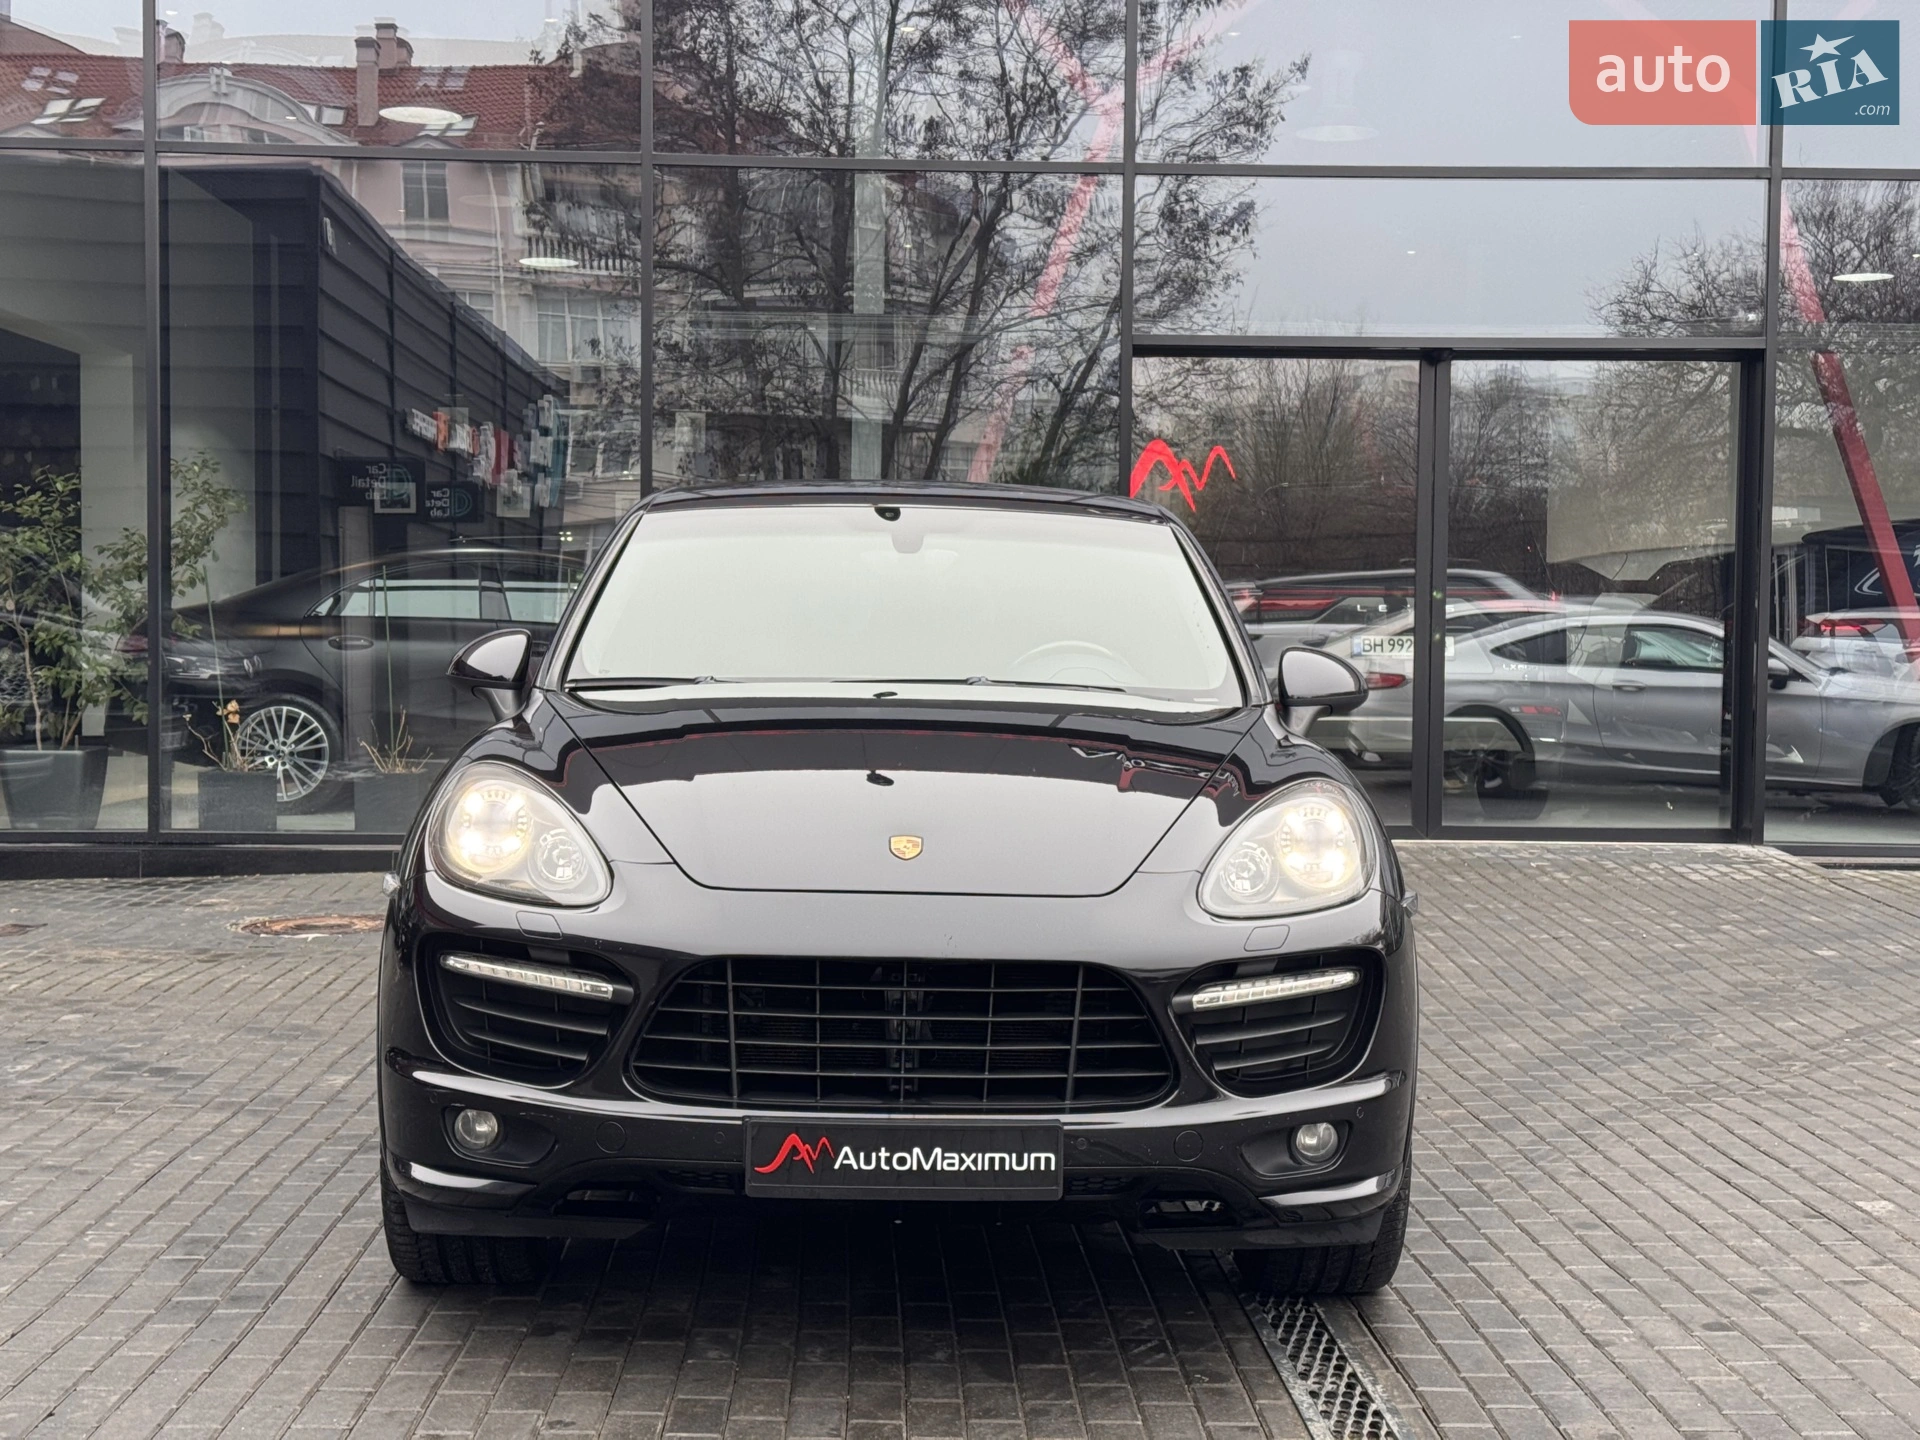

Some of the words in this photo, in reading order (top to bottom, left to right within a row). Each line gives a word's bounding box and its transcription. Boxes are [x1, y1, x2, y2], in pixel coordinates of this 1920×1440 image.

[1356, 604, 1455, 613] LES
[1362, 637, 1384, 653] BH
[1387, 637, 1414, 653] 992
[833, 1145, 1056, 1172] AutoMaximum
